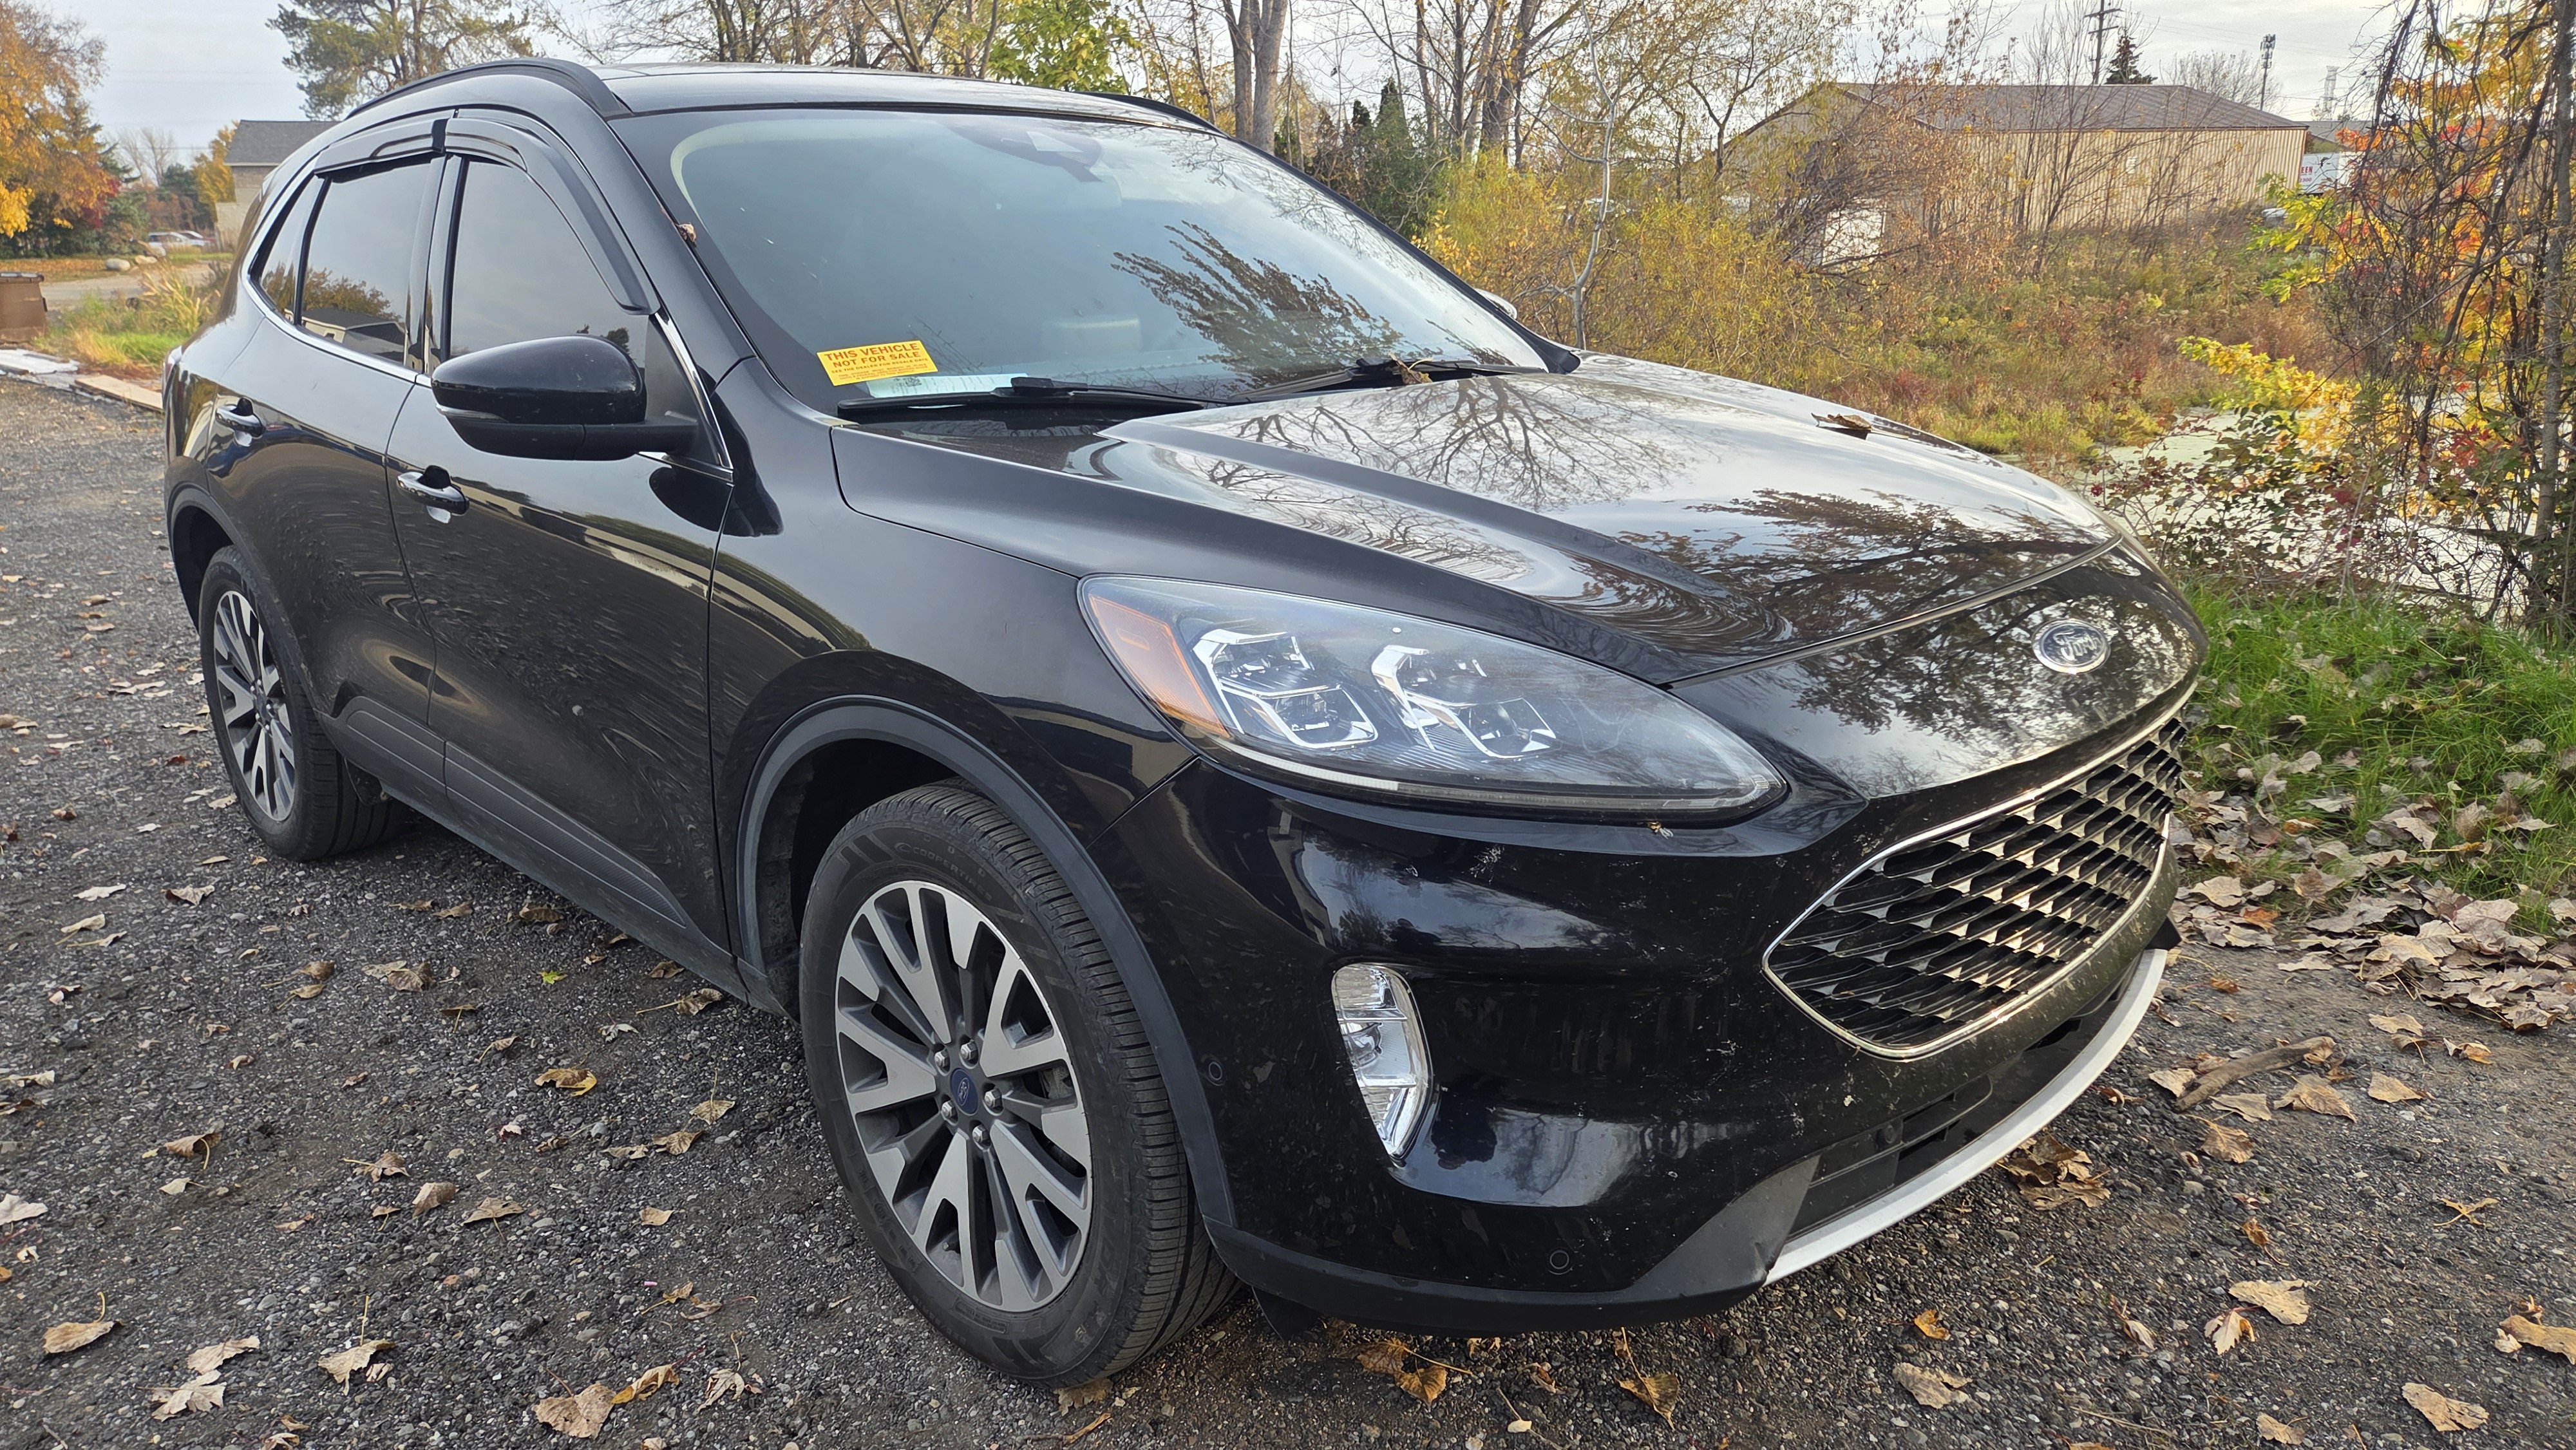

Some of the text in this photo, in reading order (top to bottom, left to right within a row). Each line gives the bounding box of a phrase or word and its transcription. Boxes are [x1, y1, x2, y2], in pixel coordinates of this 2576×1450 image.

[824, 343, 920, 361] THIS VEHICLE
[833, 359, 857, 368] NOT
[889, 352, 921, 360] SALE
[2052, 628, 2102, 661] Ford
